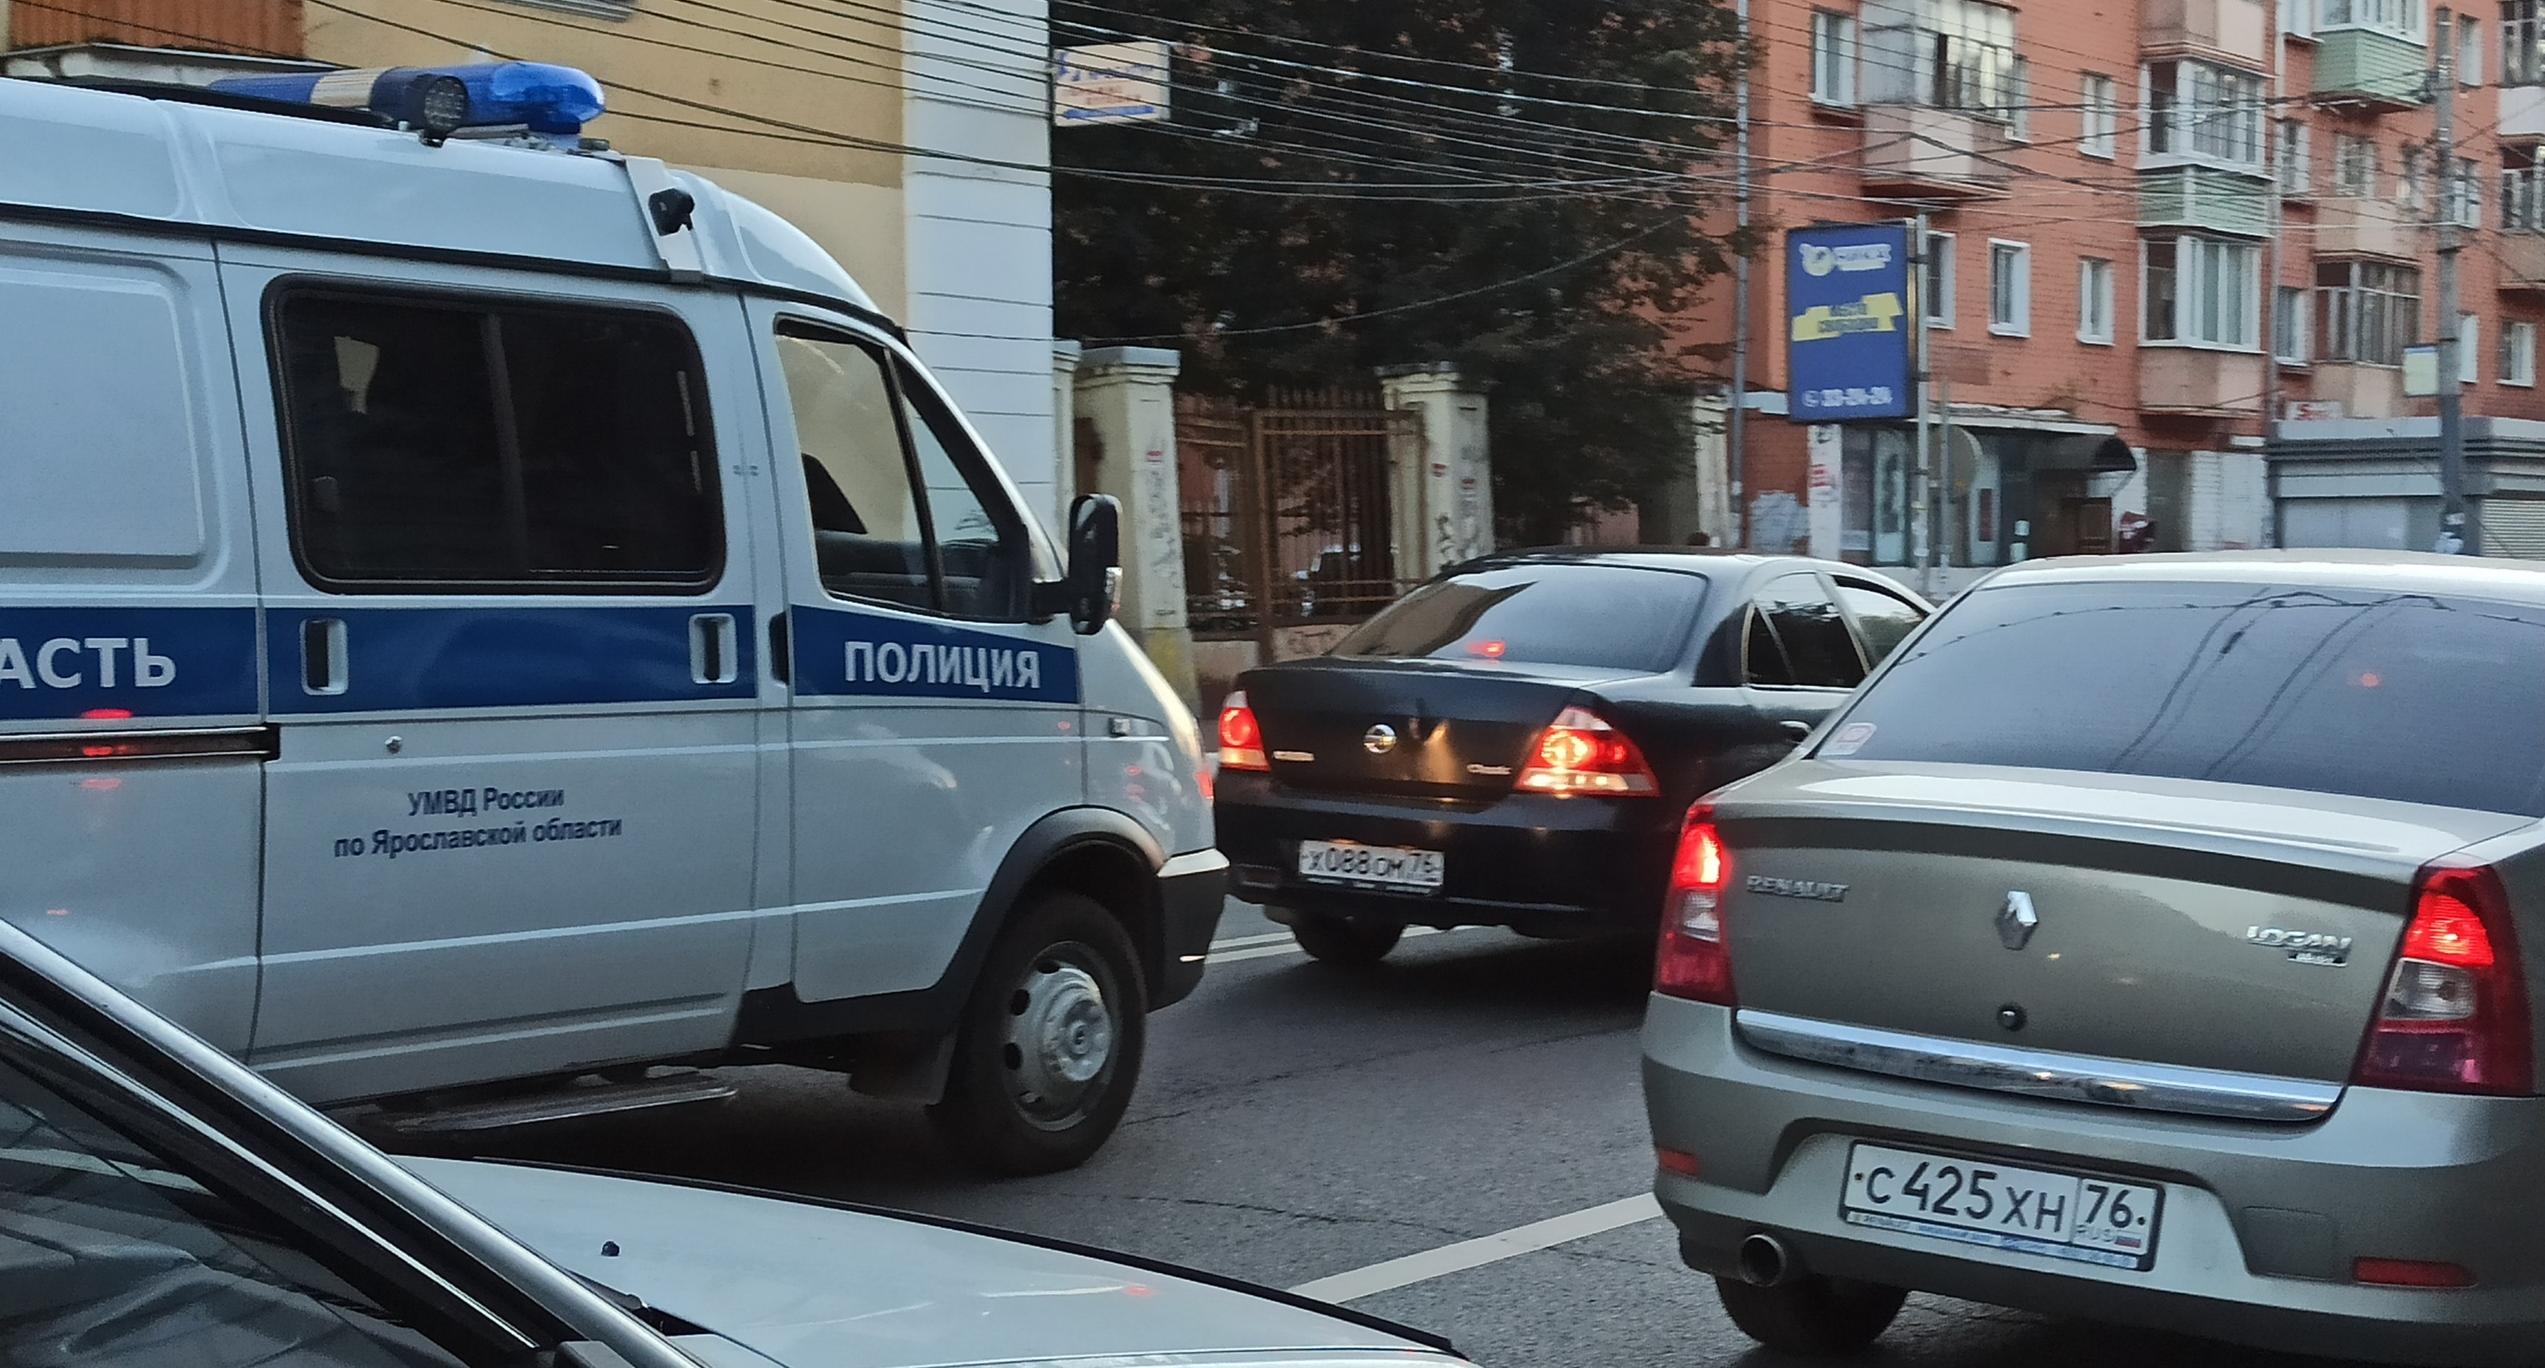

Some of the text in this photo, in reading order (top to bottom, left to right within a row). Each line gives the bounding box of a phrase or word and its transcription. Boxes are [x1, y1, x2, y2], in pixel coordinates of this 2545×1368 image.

[0, 637, 177, 689] АСТЬ
[844, 641, 1041, 693] ПОЛИЦИЯ
[408, 787, 564, 817] УМВД России
[334, 817, 622, 859] по Ярославской области
[1746, 875, 1850, 902] RENAULT
[2246, 925, 2353, 953] LOGAN
